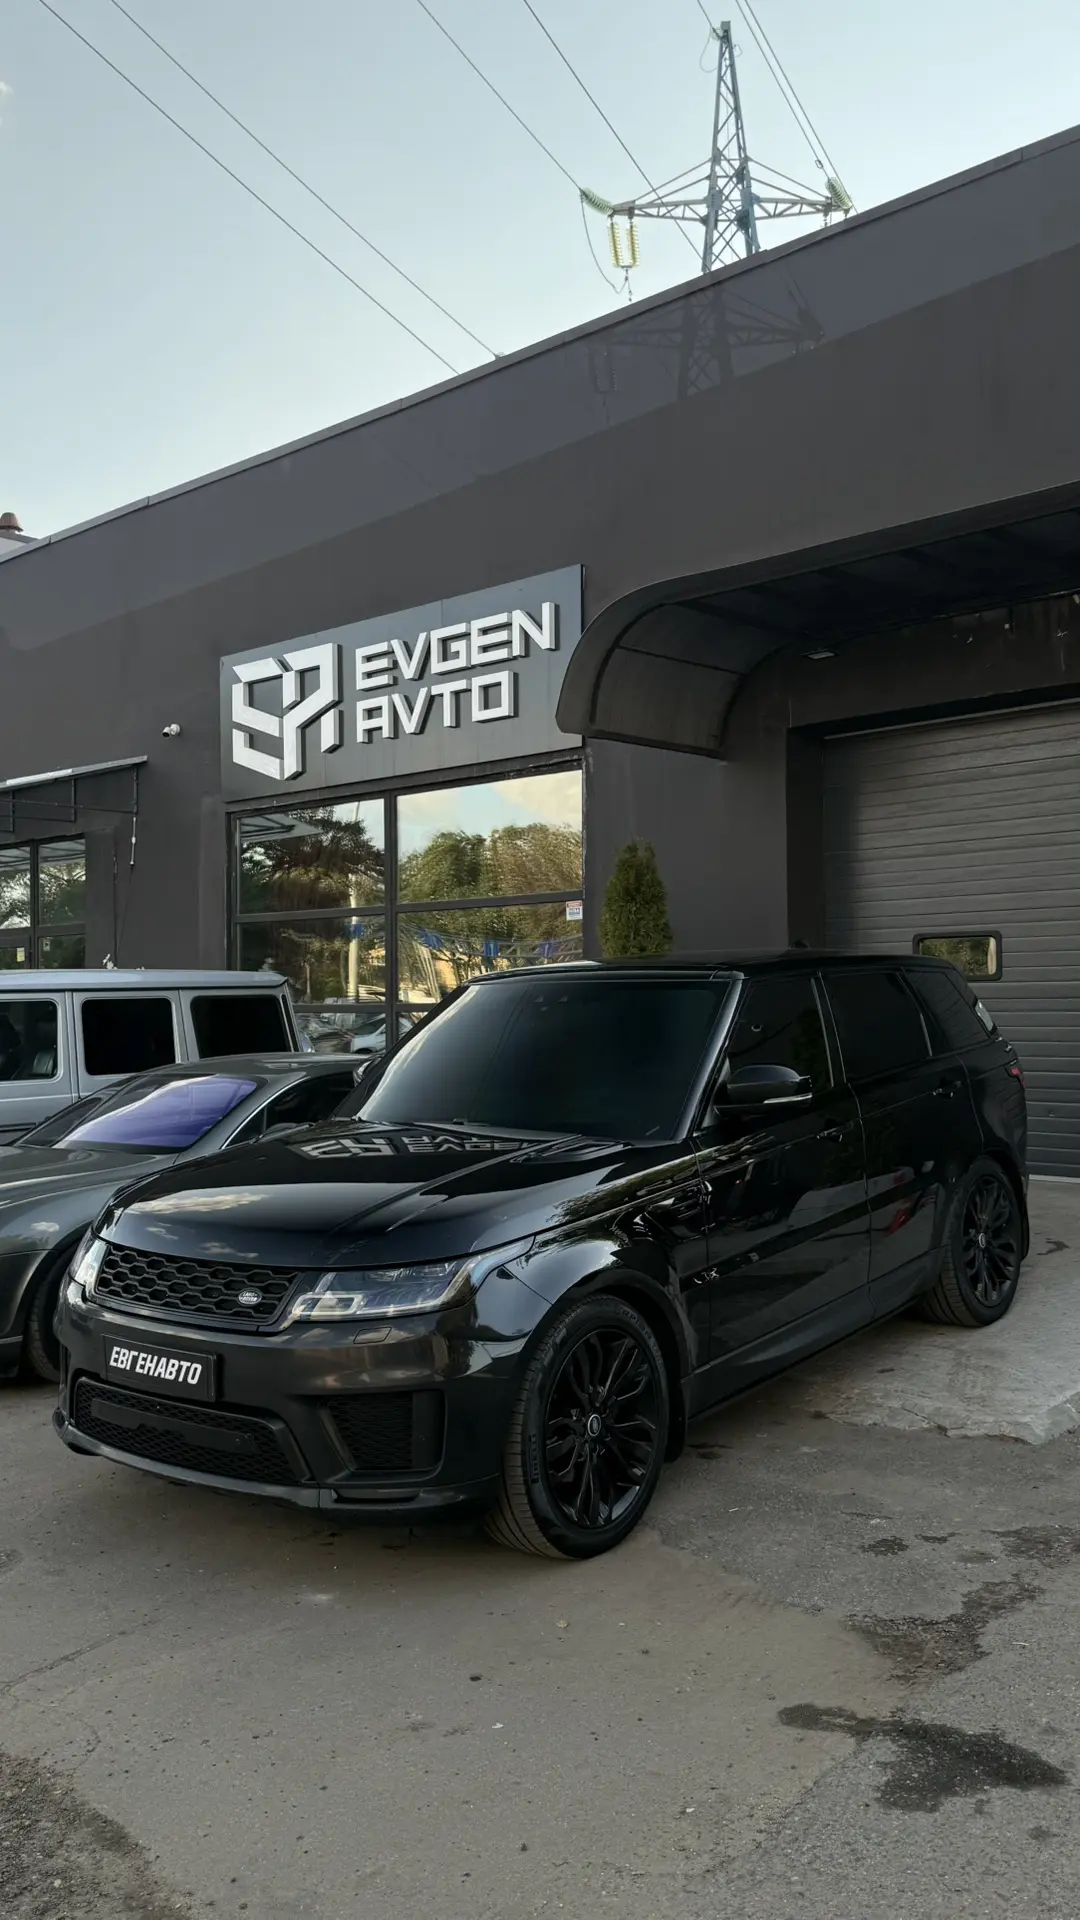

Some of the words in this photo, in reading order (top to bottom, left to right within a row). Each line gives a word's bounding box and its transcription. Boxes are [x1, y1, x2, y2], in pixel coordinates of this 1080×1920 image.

[355, 601, 557, 691] EVGEN
[356, 670, 515, 743] AVTO
[109, 1346, 202, 1385] ЕВГЕНАВТО
